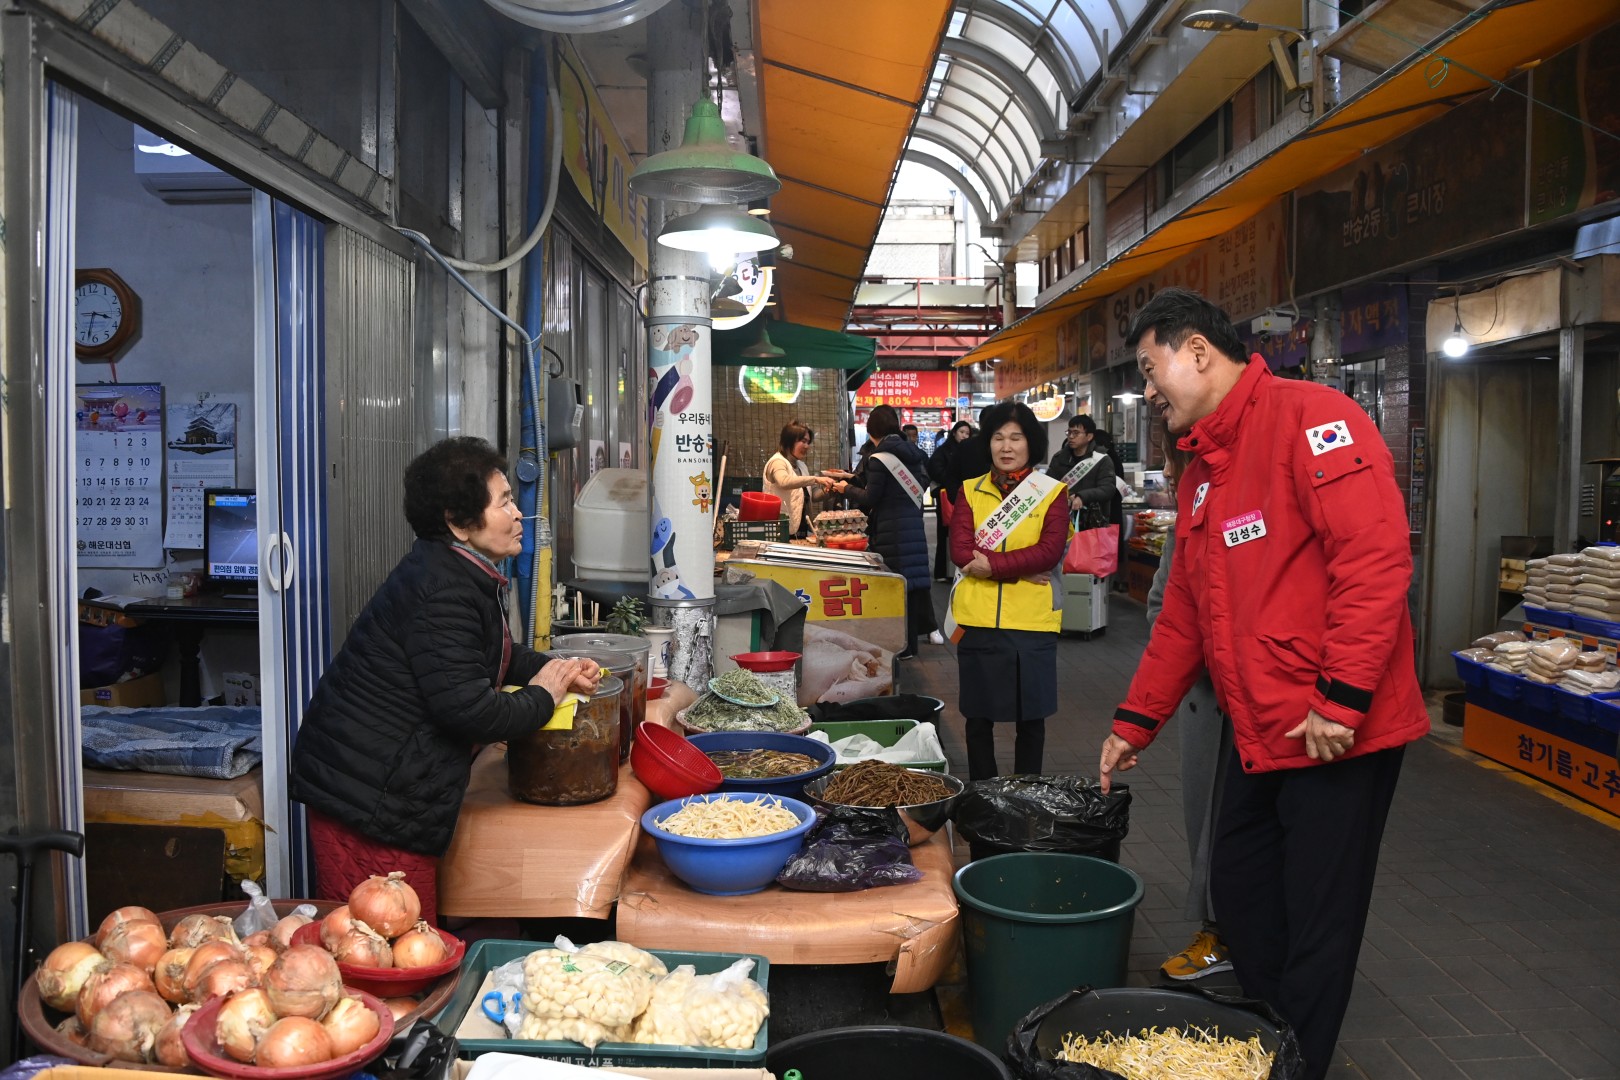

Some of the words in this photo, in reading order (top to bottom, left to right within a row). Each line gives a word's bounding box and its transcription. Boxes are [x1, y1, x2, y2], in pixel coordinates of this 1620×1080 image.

[1343, 207, 1382, 248] 반송2동
[1407, 181, 1446, 224] 큰시장
[79, 288, 86, 296] 11
[89, 284, 97, 293] 12
[103, 287, 107, 295] 1
[112, 296, 117, 304] 2
[117, 308, 121, 316] 3
[112, 321, 118, 329] 4
[81, 332, 85, 340] 7
[92, 334, 98, 343] 6
[104, 331, 109, 339] 5
[127, 438, 132, 446] 2
[141, 438, 147, 446] 3
[100, 458, 105, 466] 7
[141, 458, 150, 466] 10
[82, 478, 92, 486] 13
[97, 478, 106, 486] 14
[111, 478, 120, 486] 15
[125, 478, 134, 486] 16
[139, 478, 148, 486] 17
[82, 498, 93, 506] 20
[97, 498, 105, 506] 21
[111, 498, 120, 506] 22
[125, 498, 135, 506] 23
[139, 498, 149, 506] 24
[987, 494, 1021, 530] 전통시장
[1002, 496, 1036, 530] 시장에서
[82, 517, 92, 526] 27
[97, 517, 107, 526] 28
[111, 517, 121, 526] 29
[125, 517, 135, 526] 30
[139, 517, 148, 526] 31
[1228, 523, 1262, 544] 김성수
[88, 540, 131, 550] 해운대신협
[214, 565, 231, 574] 편의점
[819, 577, 868, 617] 닭
